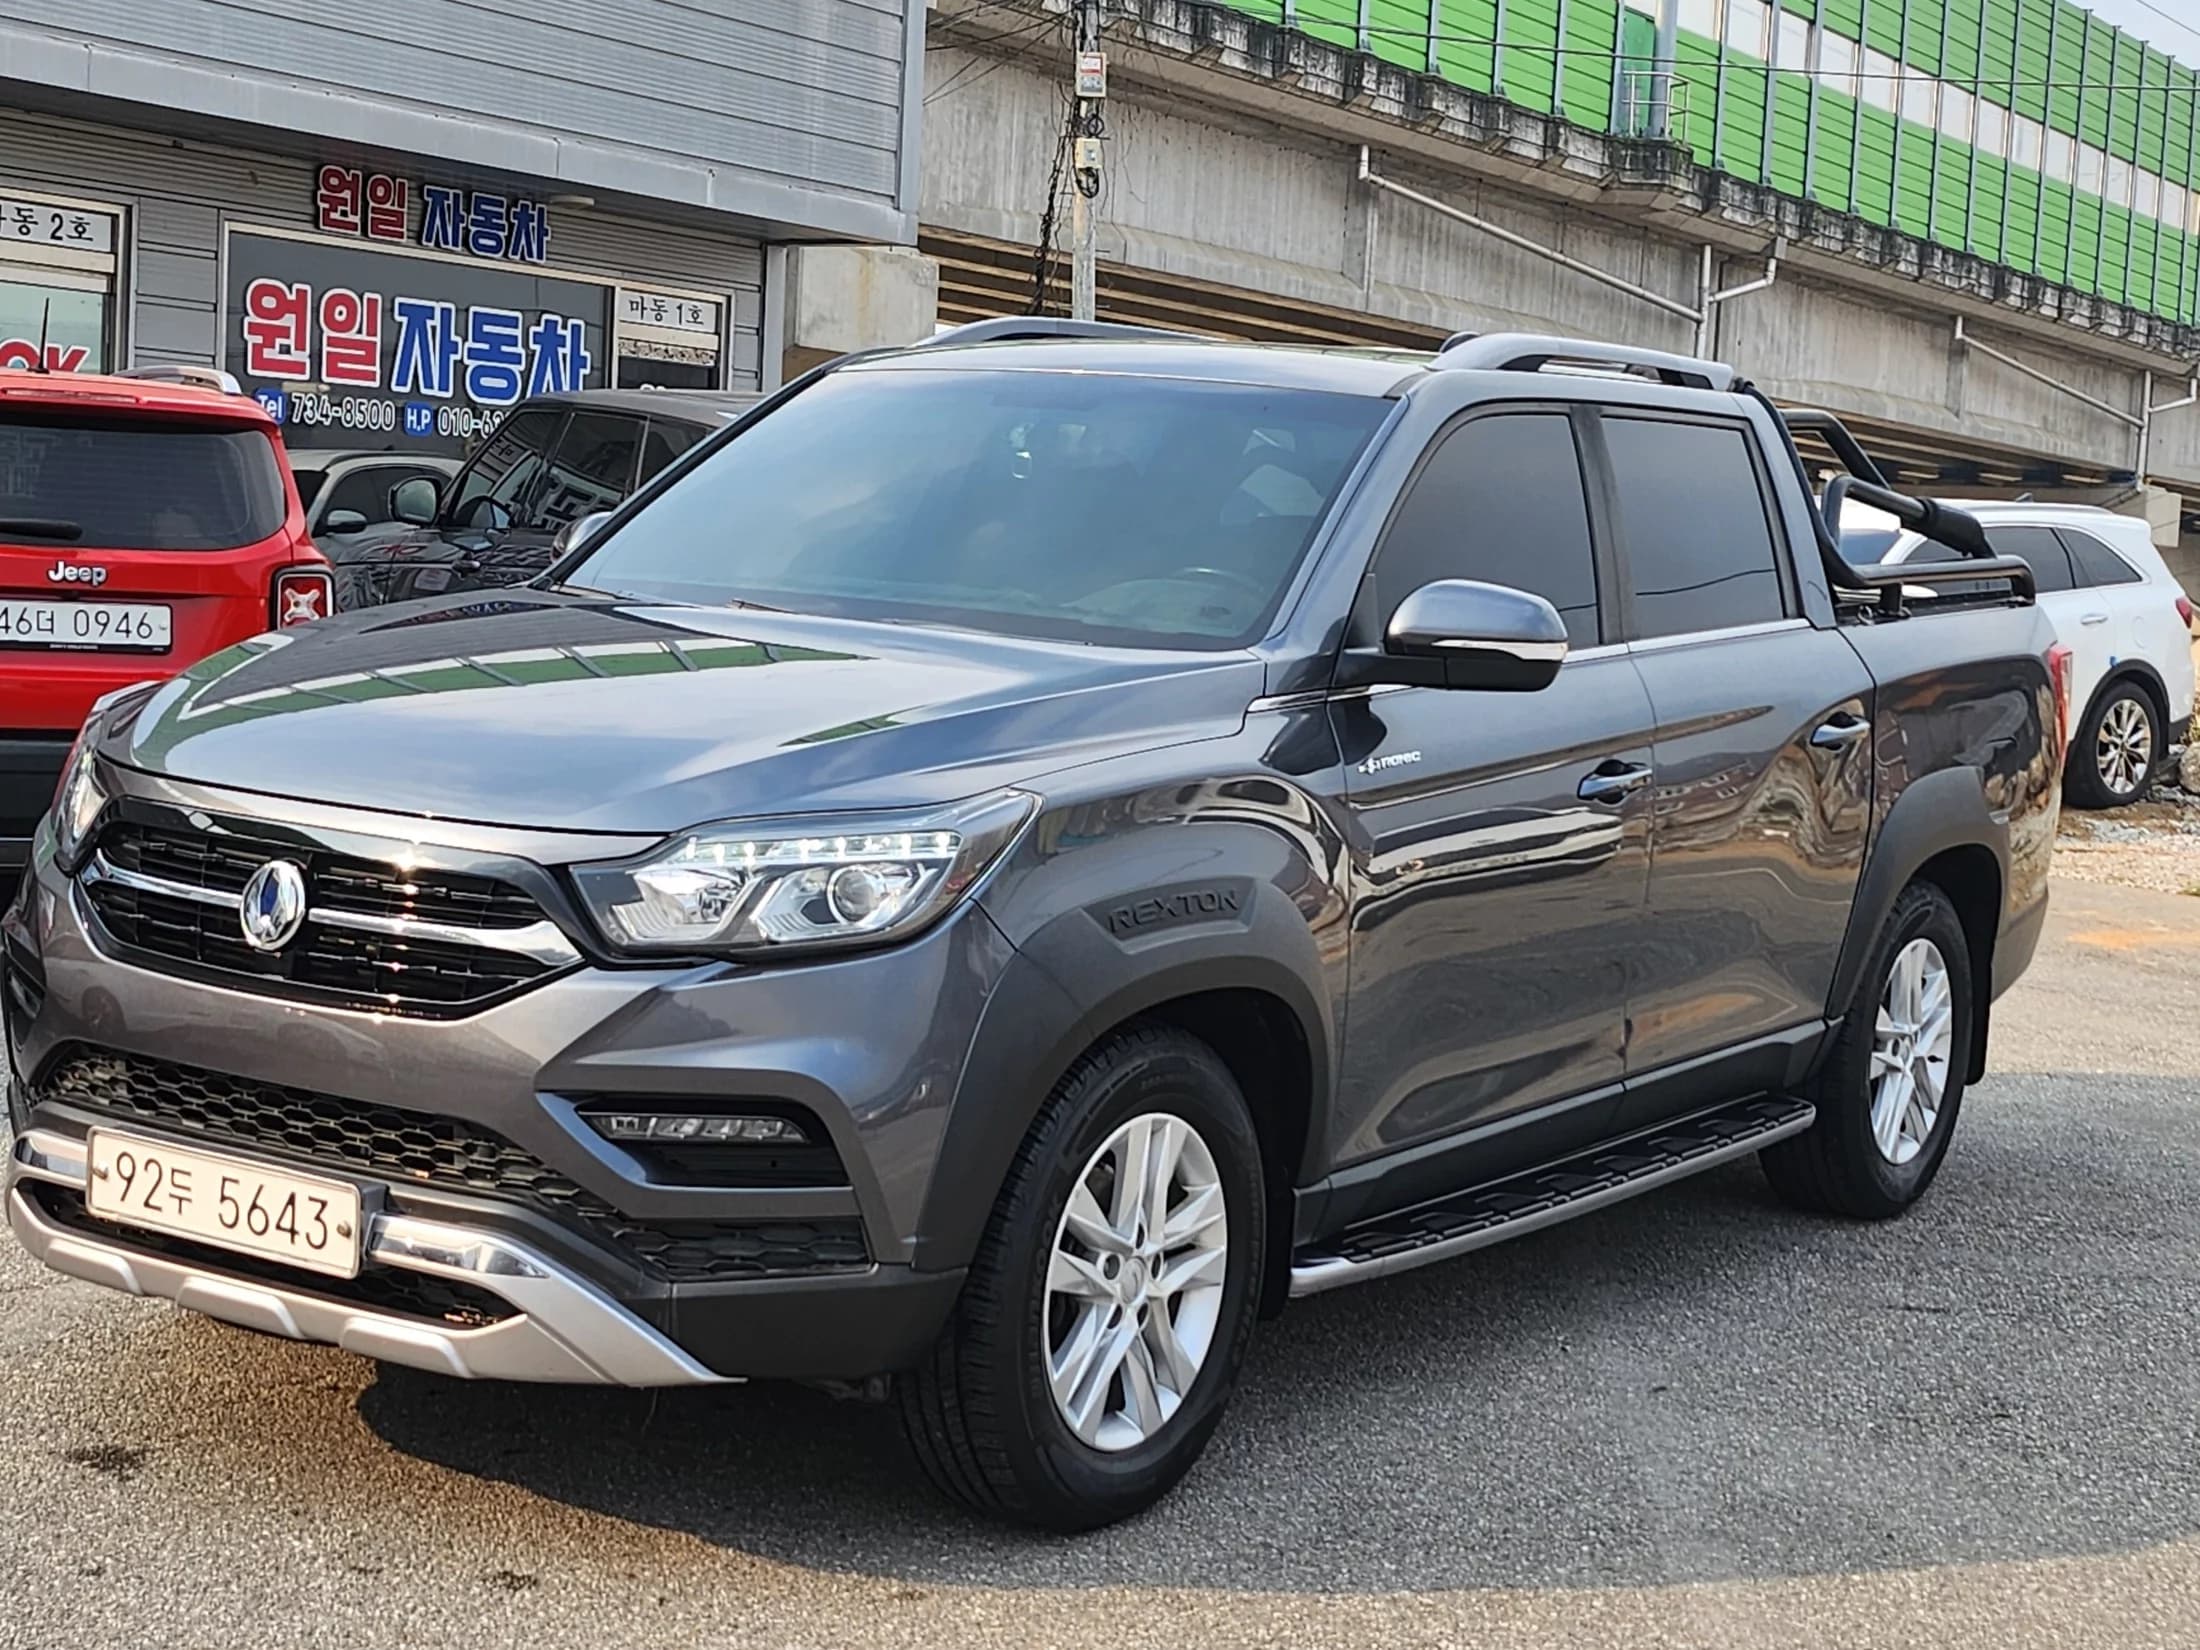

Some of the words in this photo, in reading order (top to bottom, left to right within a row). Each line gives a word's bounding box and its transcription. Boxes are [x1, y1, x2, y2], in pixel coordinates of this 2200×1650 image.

[50, 212, 94, 242] 2호
[317, 165, 408, 242] 원일
[422, 185, 551, 264] 자동차
[629, 296, 668, 322] 마동
[676, 303, 704, 325] 1호
[244, 278, 383, 388] 원일
[391, 296, 592, 406] 자동차
[291, 392, 396, 431] 734-8500
[406, 411, 431, 432] H.P
[437, 406, 510, 440] 010-6
[48, 560, 107, 586] Jeep
[0, 606, 55, 637] 46더
[73, 608, 153, 640] 0946
[1108, 890, 1238, 934] REXTON
[116, 1151, 193, 1215] 92두
[218, 1175, 328, 1250] 5643
